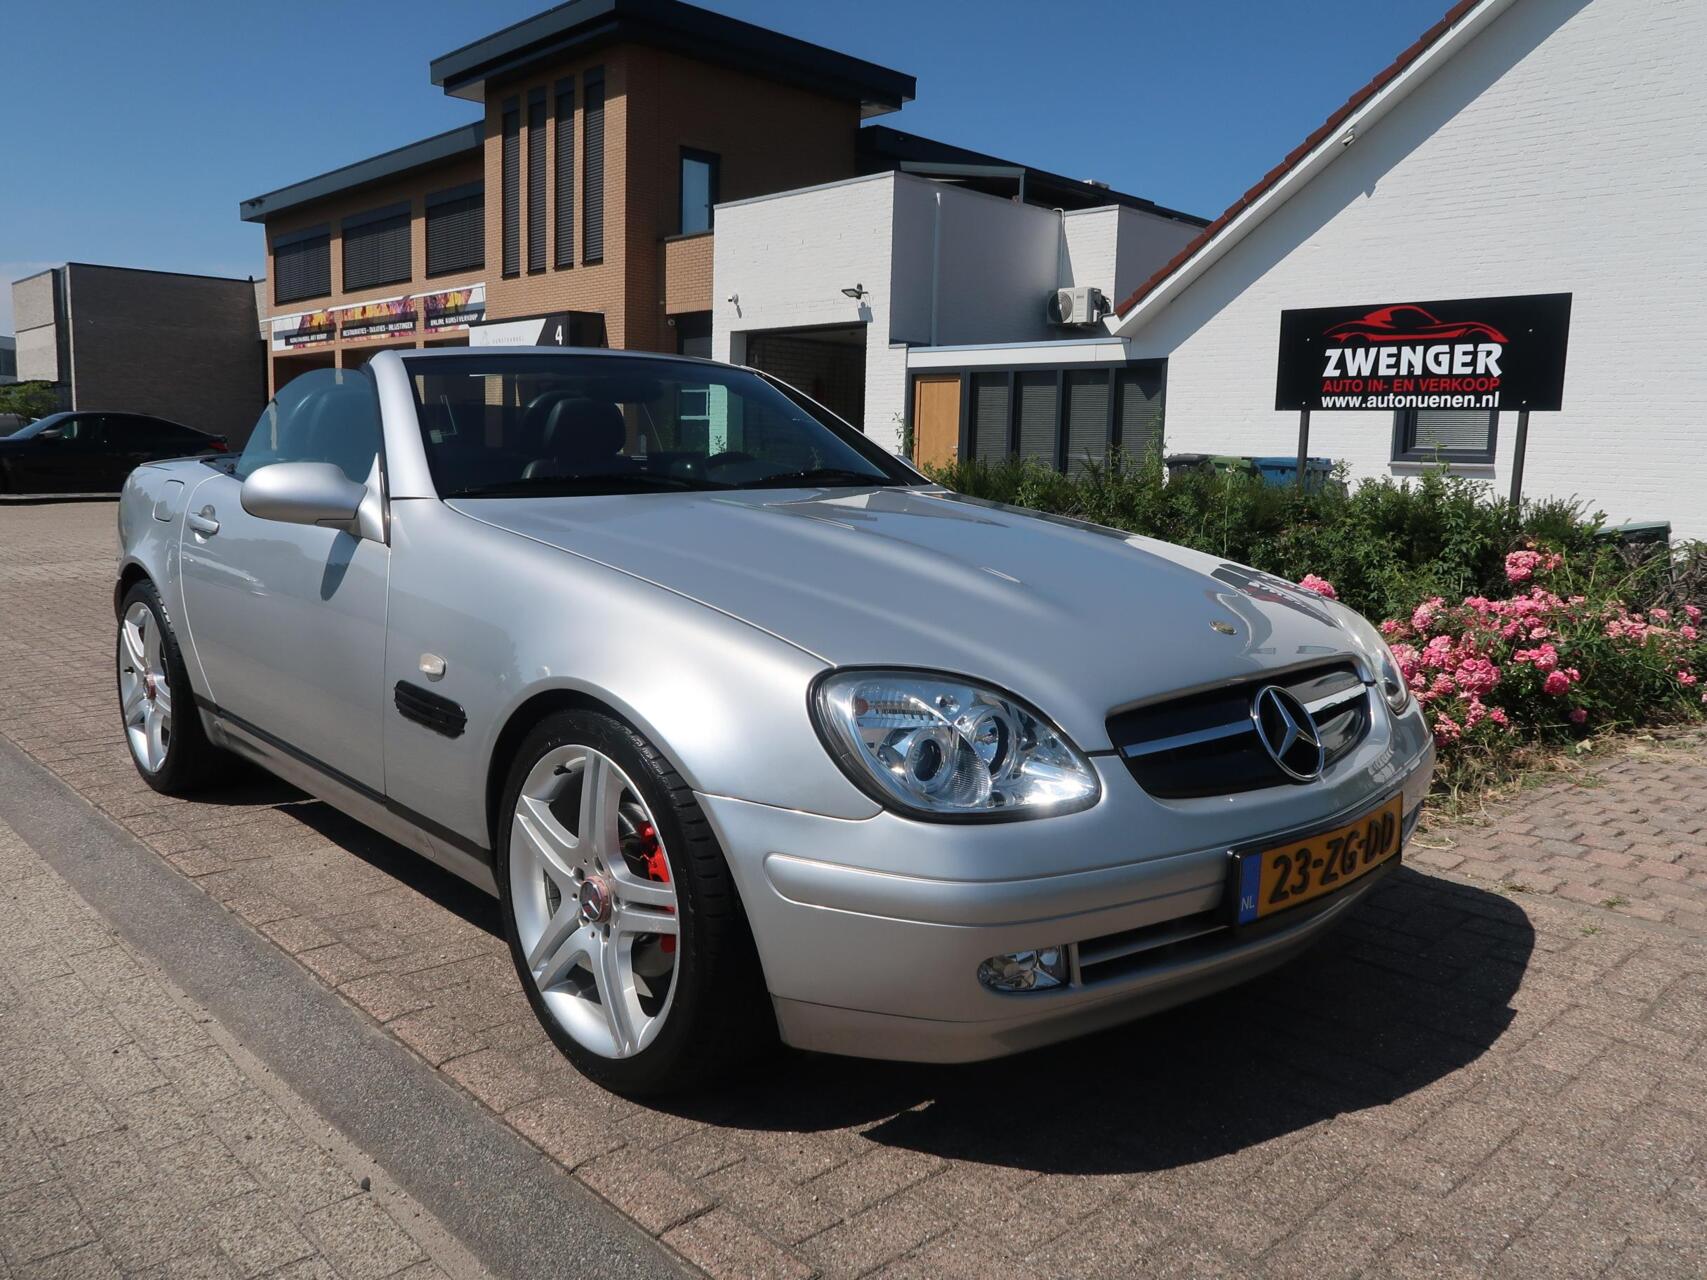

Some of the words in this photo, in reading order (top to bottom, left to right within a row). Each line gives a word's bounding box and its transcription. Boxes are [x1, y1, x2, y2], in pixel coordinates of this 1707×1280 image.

[555, 325, 563, 346] 4
[1322, 343, 1503, 378] ZWENGER
[1323, 379, 1364, 393] AUTO
[1367, 379, 1388, 392] IN-
[1393, 379, 1415, 392] EN
[1419, 377, 1501, 392] VERKOOP
[1321, 392, 1500, 408] www.autonuenen.nl
[1268, 810, 1395, 905] 23-ZG-DD
[1240, 895, 1255, 912] NL
